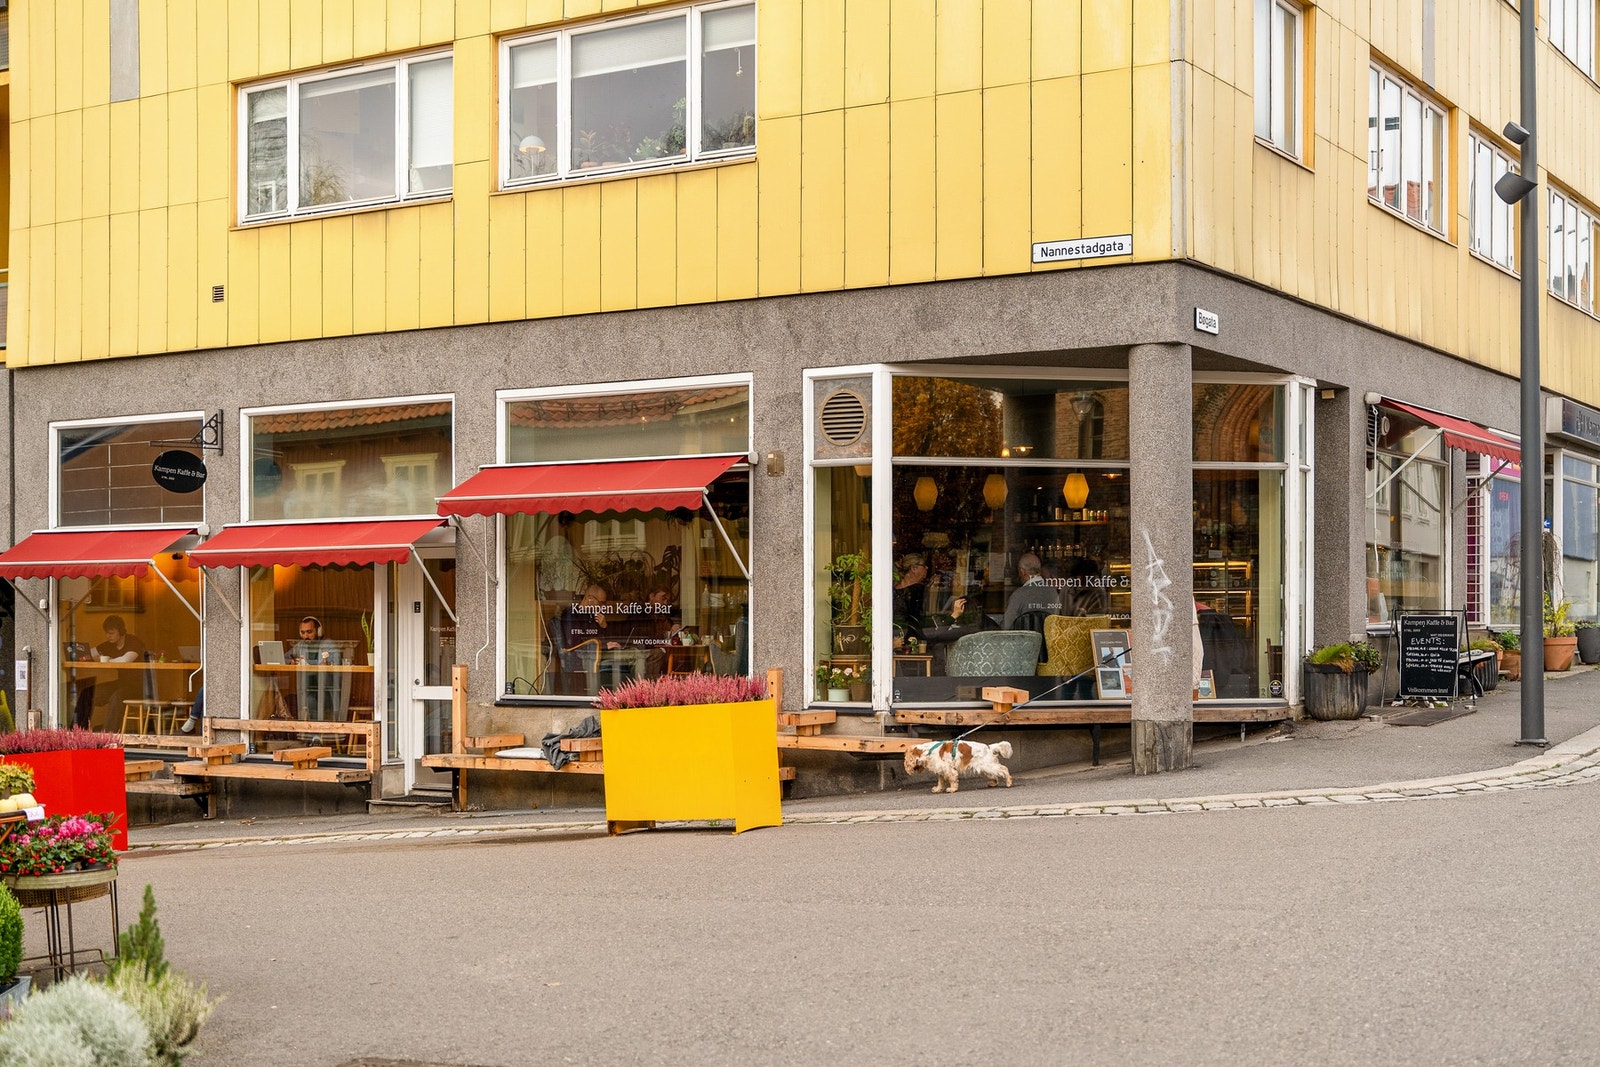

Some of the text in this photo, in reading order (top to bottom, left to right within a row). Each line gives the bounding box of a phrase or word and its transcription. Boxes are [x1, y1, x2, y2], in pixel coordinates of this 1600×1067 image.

[1040, 241, 1124, 257] Nannestadgata
[1028, 575, 1130, 589] Kampen Kaffe &
[571, 602, 672, 616] Kampen Kaffe & Bar
